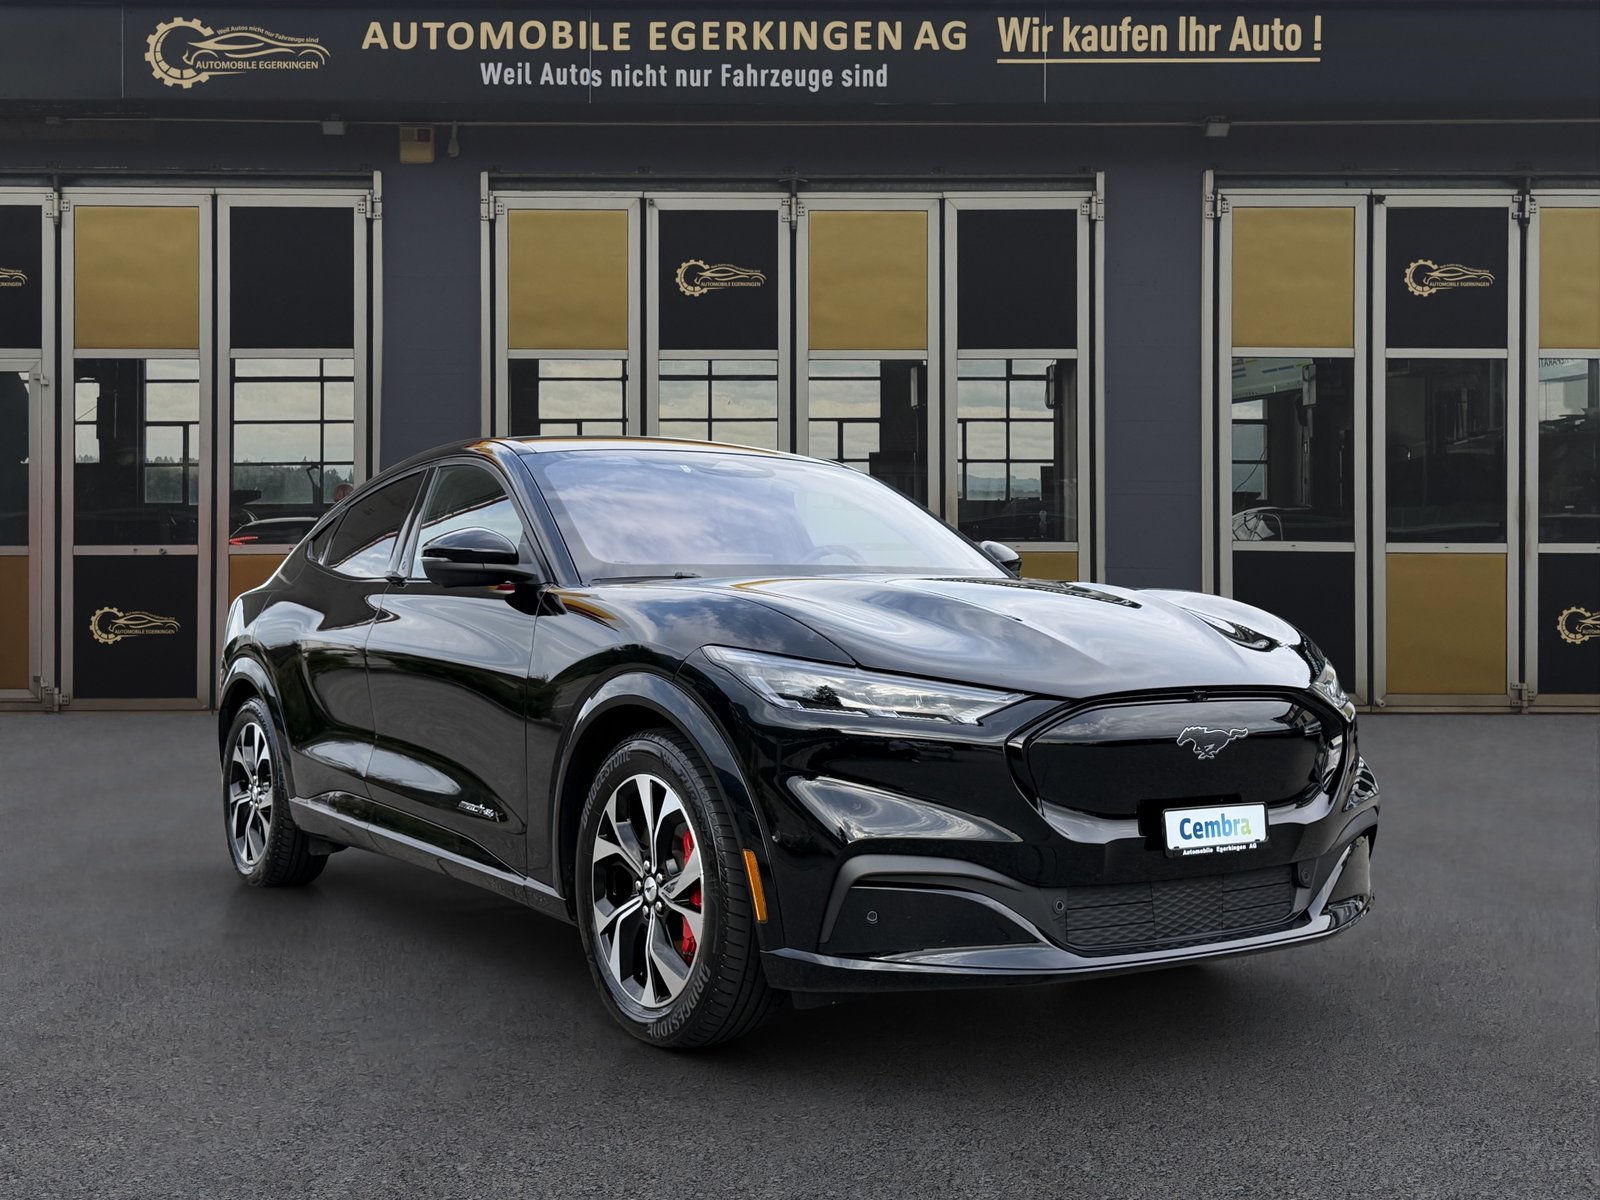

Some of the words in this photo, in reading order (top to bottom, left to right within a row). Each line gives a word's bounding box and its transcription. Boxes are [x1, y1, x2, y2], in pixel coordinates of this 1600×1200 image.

[249, 26, 265, 34] nicht
[275, 33, 305, 43] Fahrzeuge
[362, 21, 631, 51] AUTOMOBILE
[649, 20, 902, 51] EGERKINGEN
[913, 20, 967, 51] AG
[998, 17, 1054, 52] Wir
[1063, 17, 1168, 53] kaufen
[1179, 16, 1222, 52] Ihr
[1229, 16, 1302, 52] Auto
[195, 60, 257, 69] AUTOMOBILE
[258, 60, 319, 69] EGERKINGEN
[480, 62, 532, 86] Weil
[540, 63, 603, 88] Autos
[611, 64, 668, 89] nicht
[676, 69, 713, 88] nur
[722, 64, 833, 93] Fahrzeuge
[842, 64, 888, 88] sind
[1179, 813, 1252, 840] Cembra
[1183, 847, 1214, 856] Automobile
[1216, 844, 1247, 853] Egerkingen
